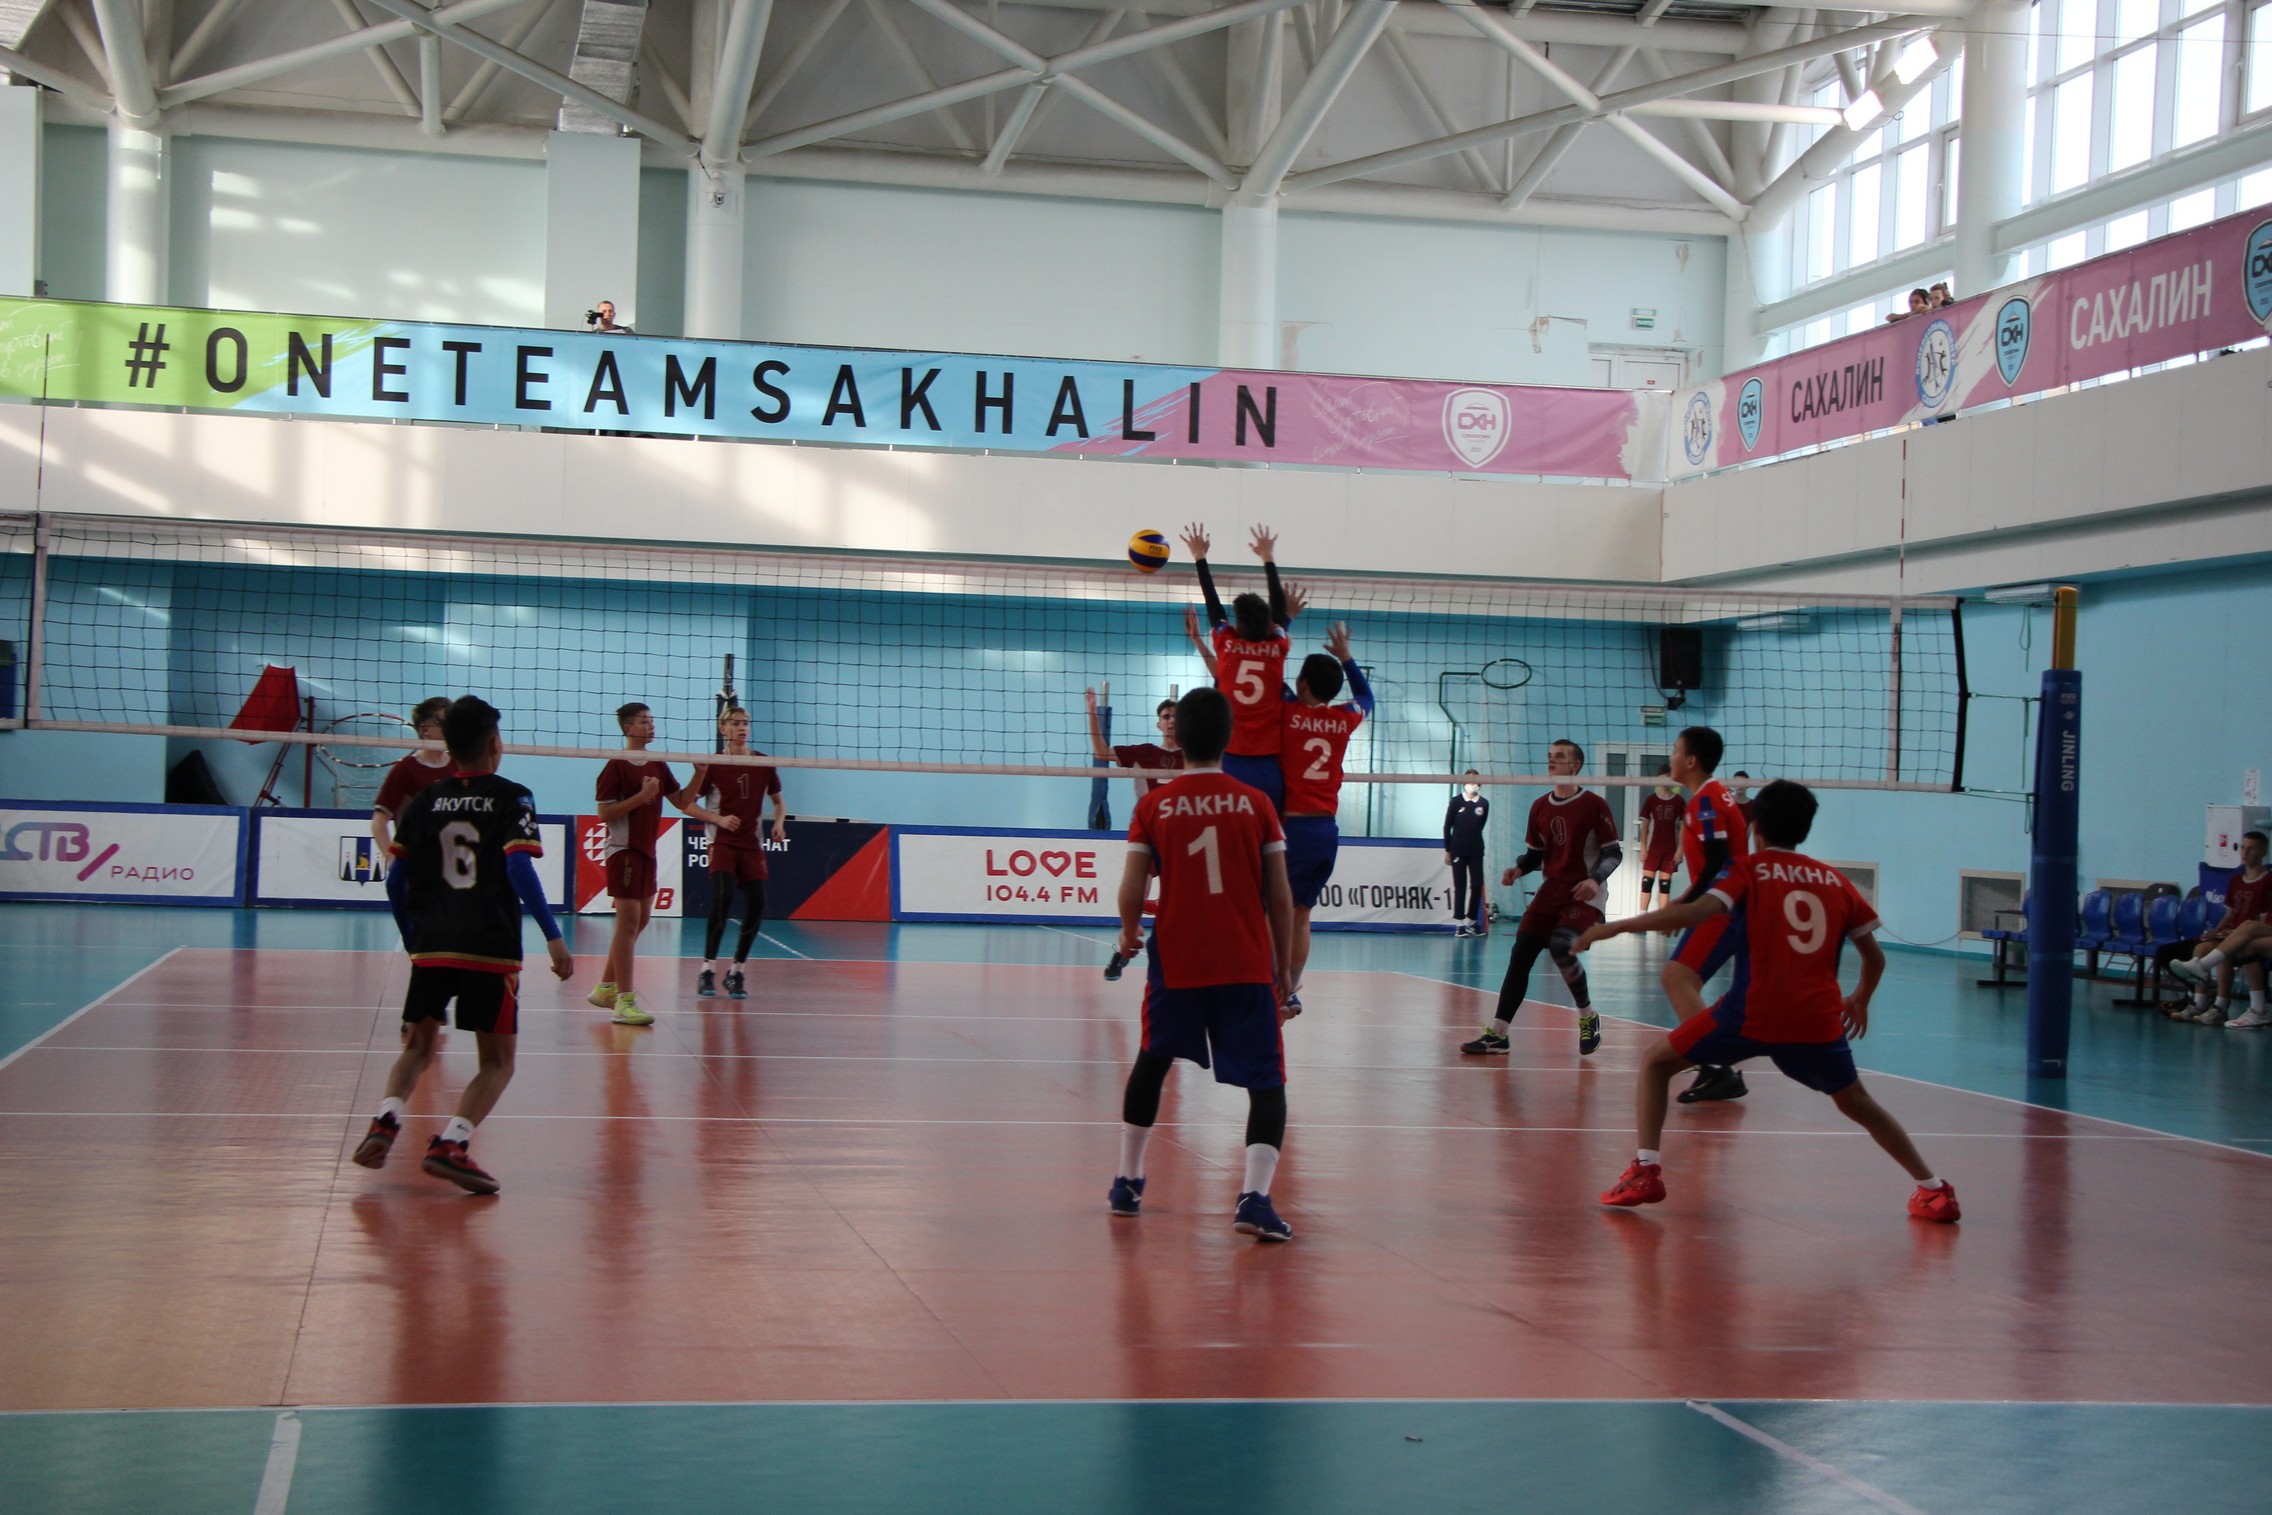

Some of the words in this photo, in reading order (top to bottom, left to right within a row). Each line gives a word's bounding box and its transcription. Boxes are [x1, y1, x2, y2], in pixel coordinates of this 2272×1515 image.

[2071, 260, 2213, 350] САХАЛИН
[125, 321, 1278, 449] #ONETEAMSAKHALIN
[1791, 357, 1885, 424] САХАЛИН
[1223, 638, 1281, 657] SAKHA
[1233, 661, 1265, 705] 5
[1290, 714, 1348, 735] SAKHA
[1302, 738, 1332, 780] 2
[2060, 730, 2076, 792] JINLING
[737, 773, 749, 799] 1
[431, 795, 495, 814] ЯКУТСК
[1158, 794, 1255, 820] SAKHA
[1655, 804, 1675, 820] 15
[0, 821, 90, 861] СТВ
[1550, 815, 1567, 846] 9
[440, 820, 482, 890] 6
[1187, 826, 1224, 895] 1
[111, 866, 195, 882] РАДИО
[1754, 861, 1843, 887] SAKHA
[987, 885, 1051, 903] 104.4
[1061, 886, 1098, 904] FM
[1783, 890, 1827, 955] 9
